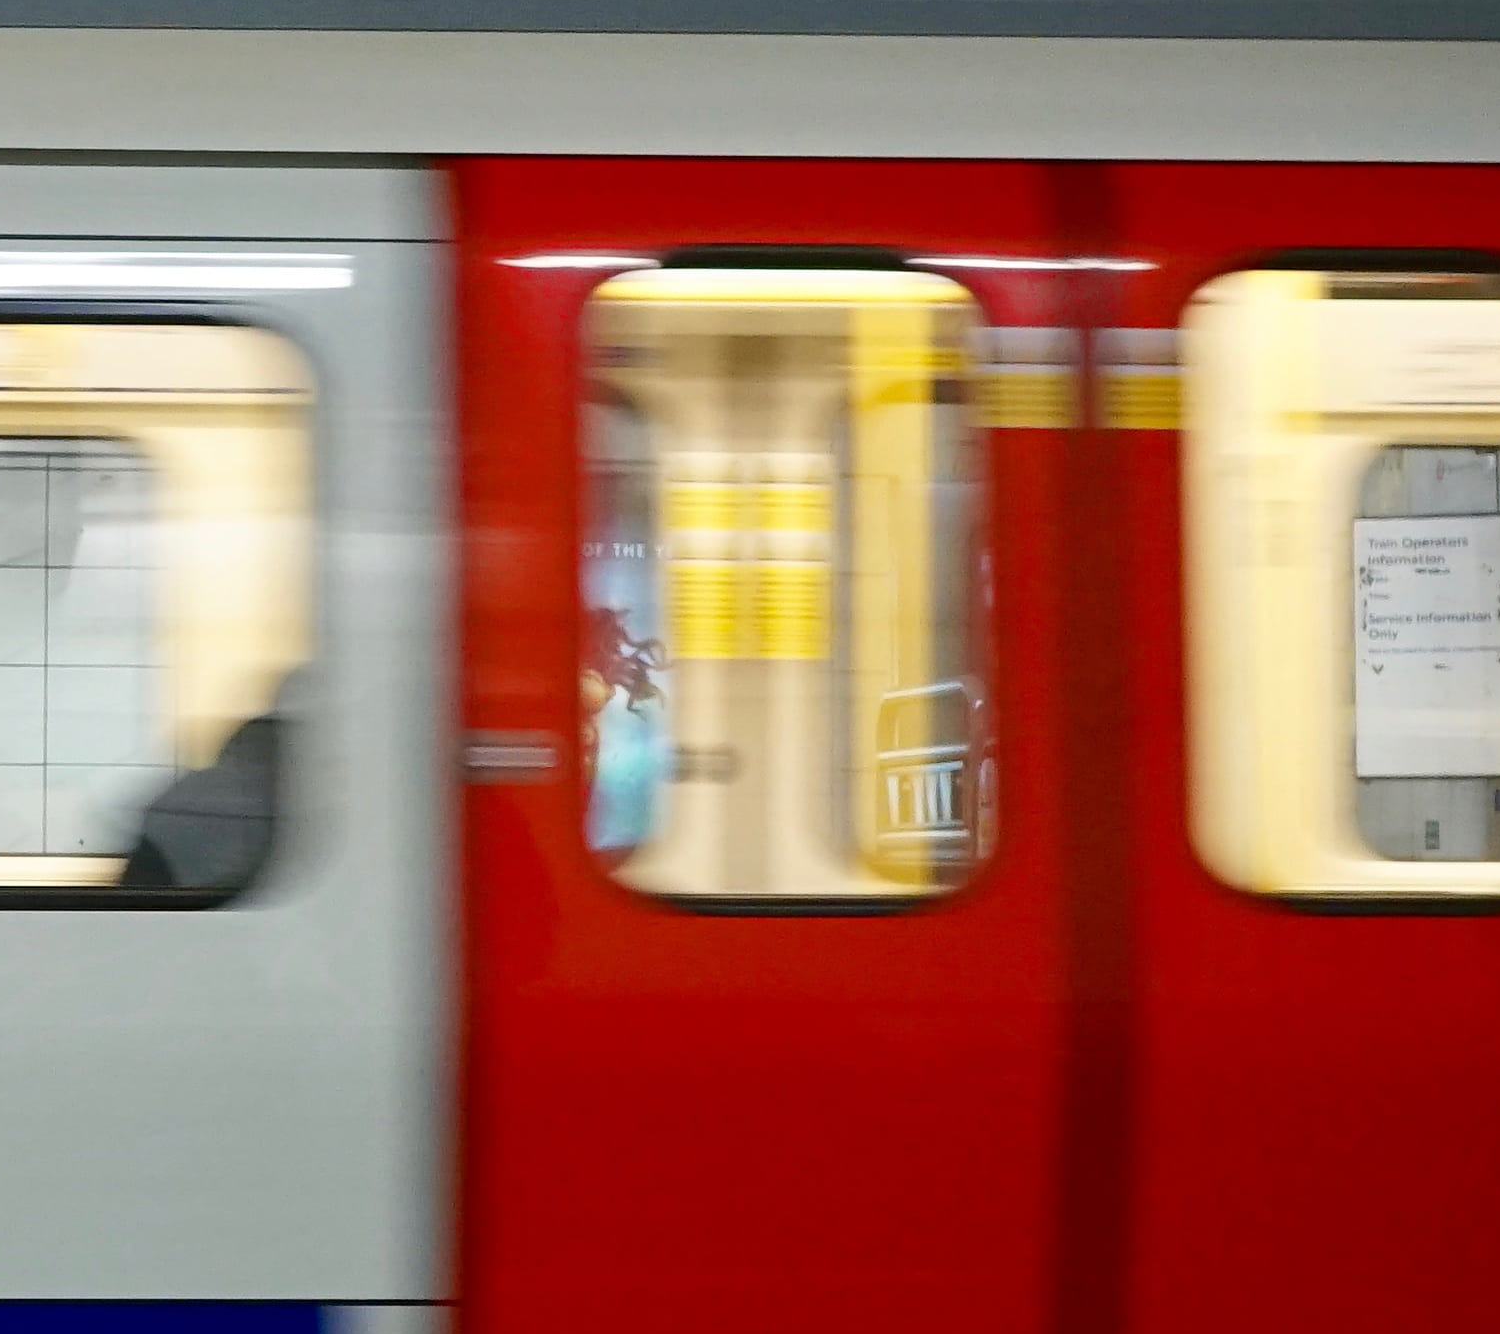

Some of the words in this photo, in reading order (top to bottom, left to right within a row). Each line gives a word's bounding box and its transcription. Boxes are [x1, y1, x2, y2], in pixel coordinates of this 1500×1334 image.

[1368, 538, 1398, 549] Train
[1401, 536, 1469, 550] Operators
[612, 542, 646, 558] THE
[1367, 554, 1446, 565] Information
[1368, 613, 1413, 624] Service
[1416, 611, 1492, 624] Information
[1368, 628, 1398, 641] Only
